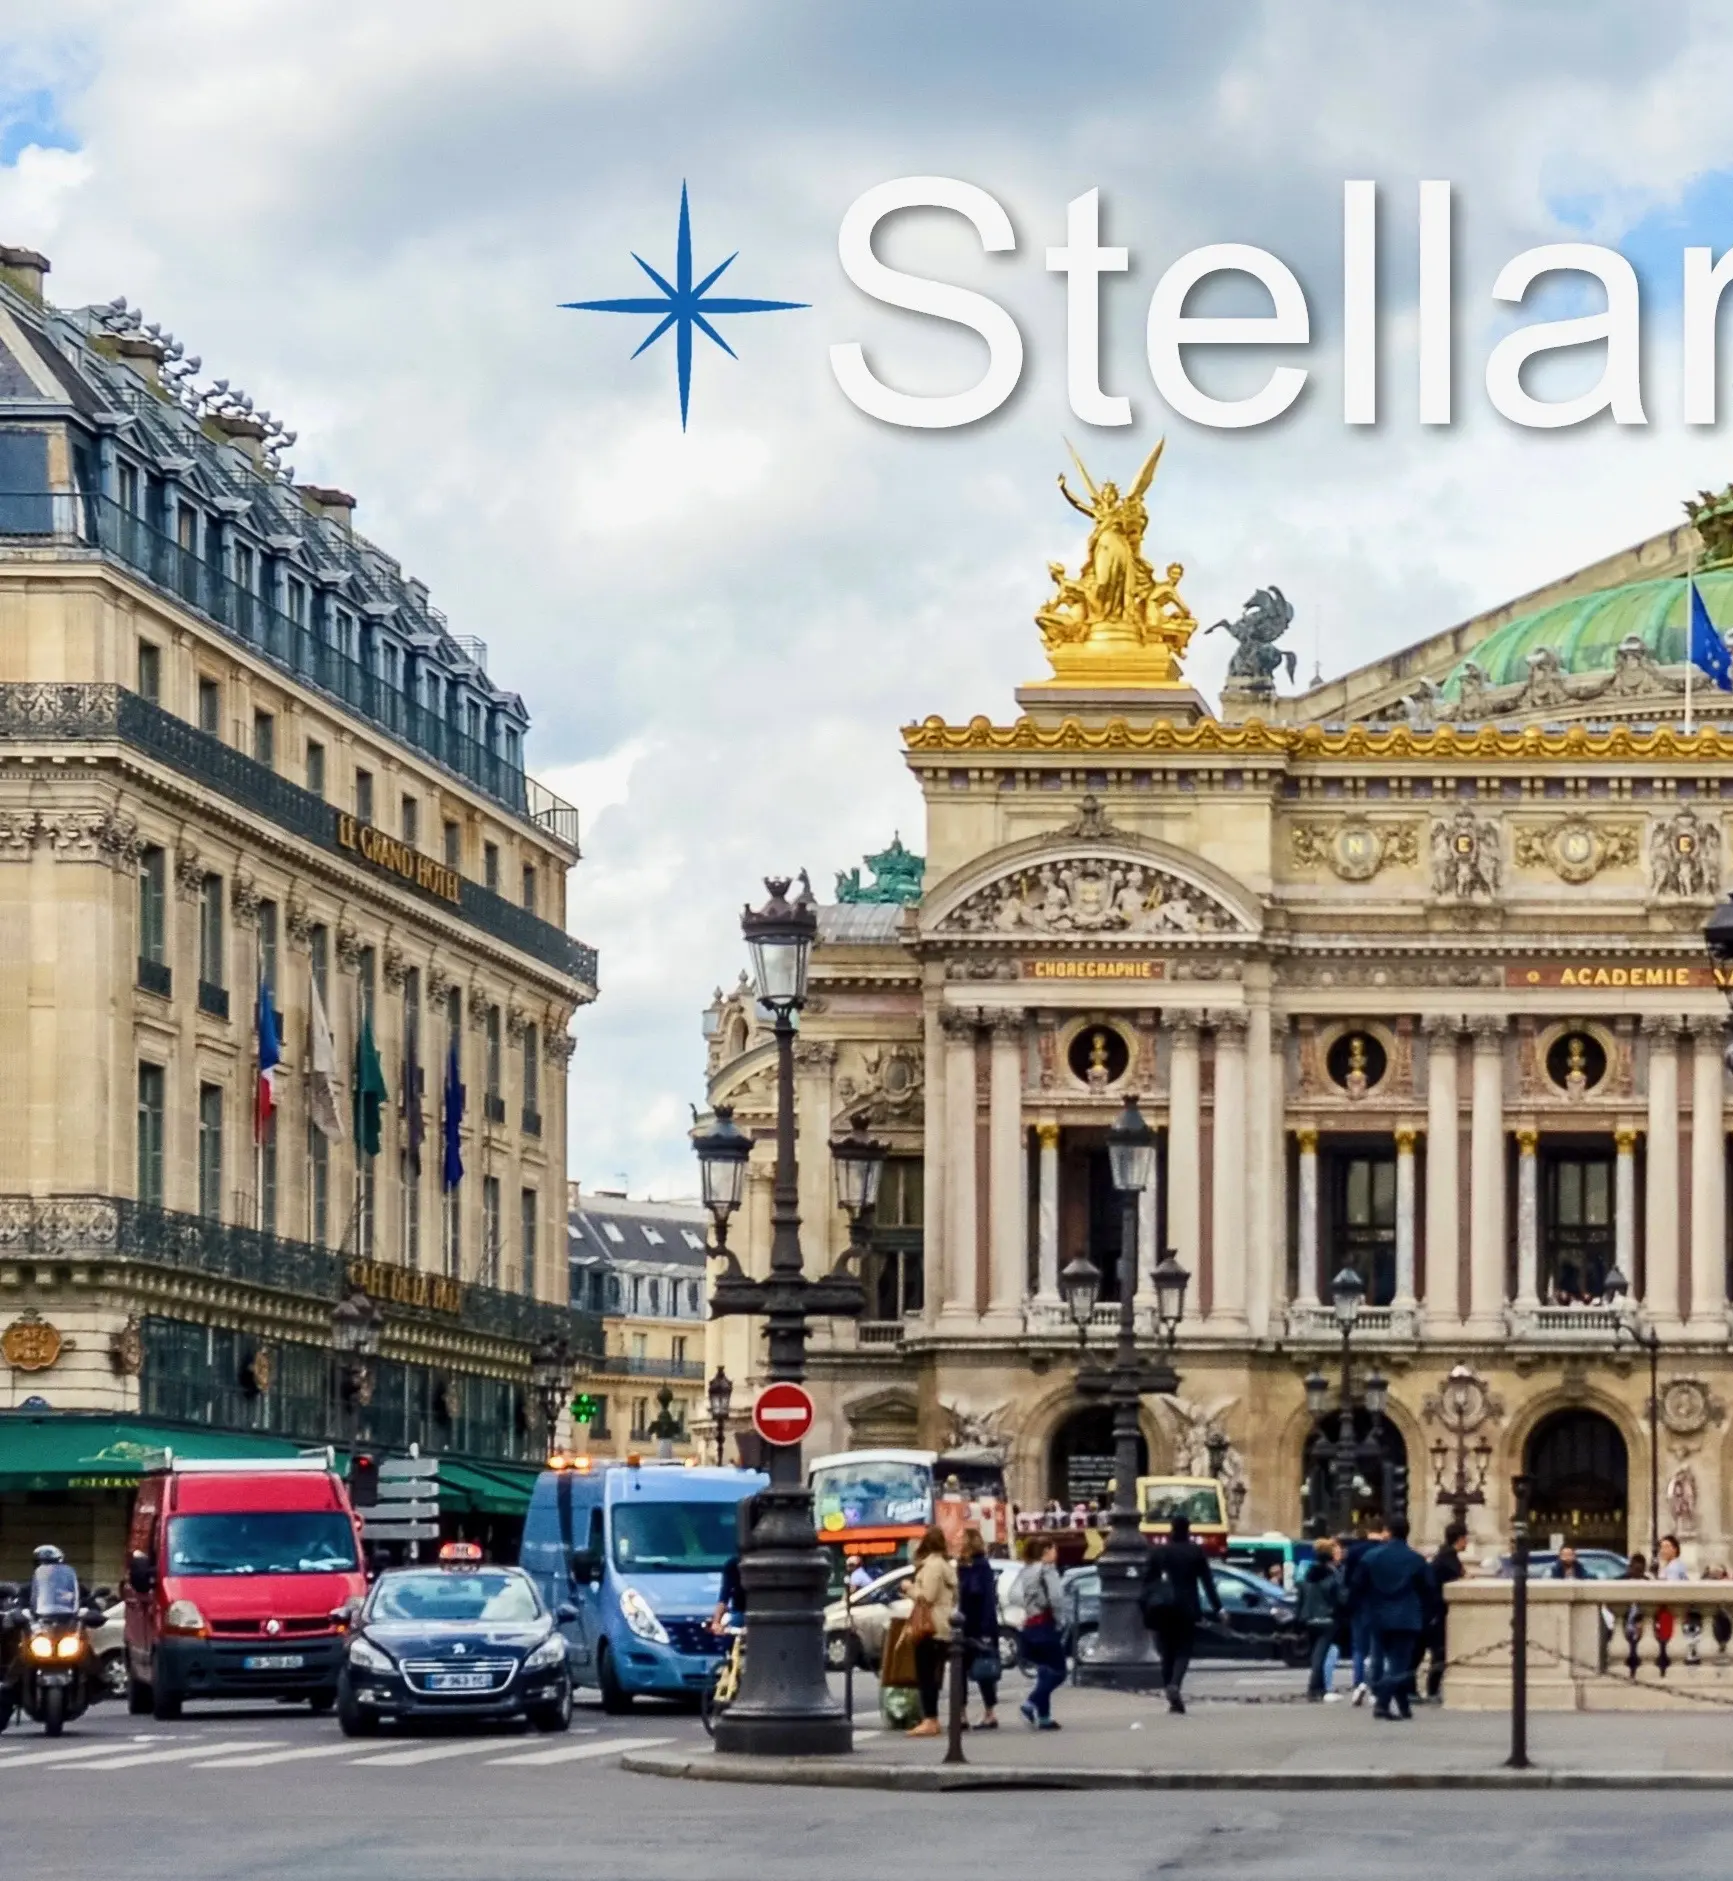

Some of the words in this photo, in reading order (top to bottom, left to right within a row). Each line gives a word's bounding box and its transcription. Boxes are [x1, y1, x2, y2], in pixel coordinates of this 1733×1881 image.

[340, 813, 358, 850] LE
[360, 826, 414, 879] GRAND
[1560, 968, 1689, 985] ACADEMIE
